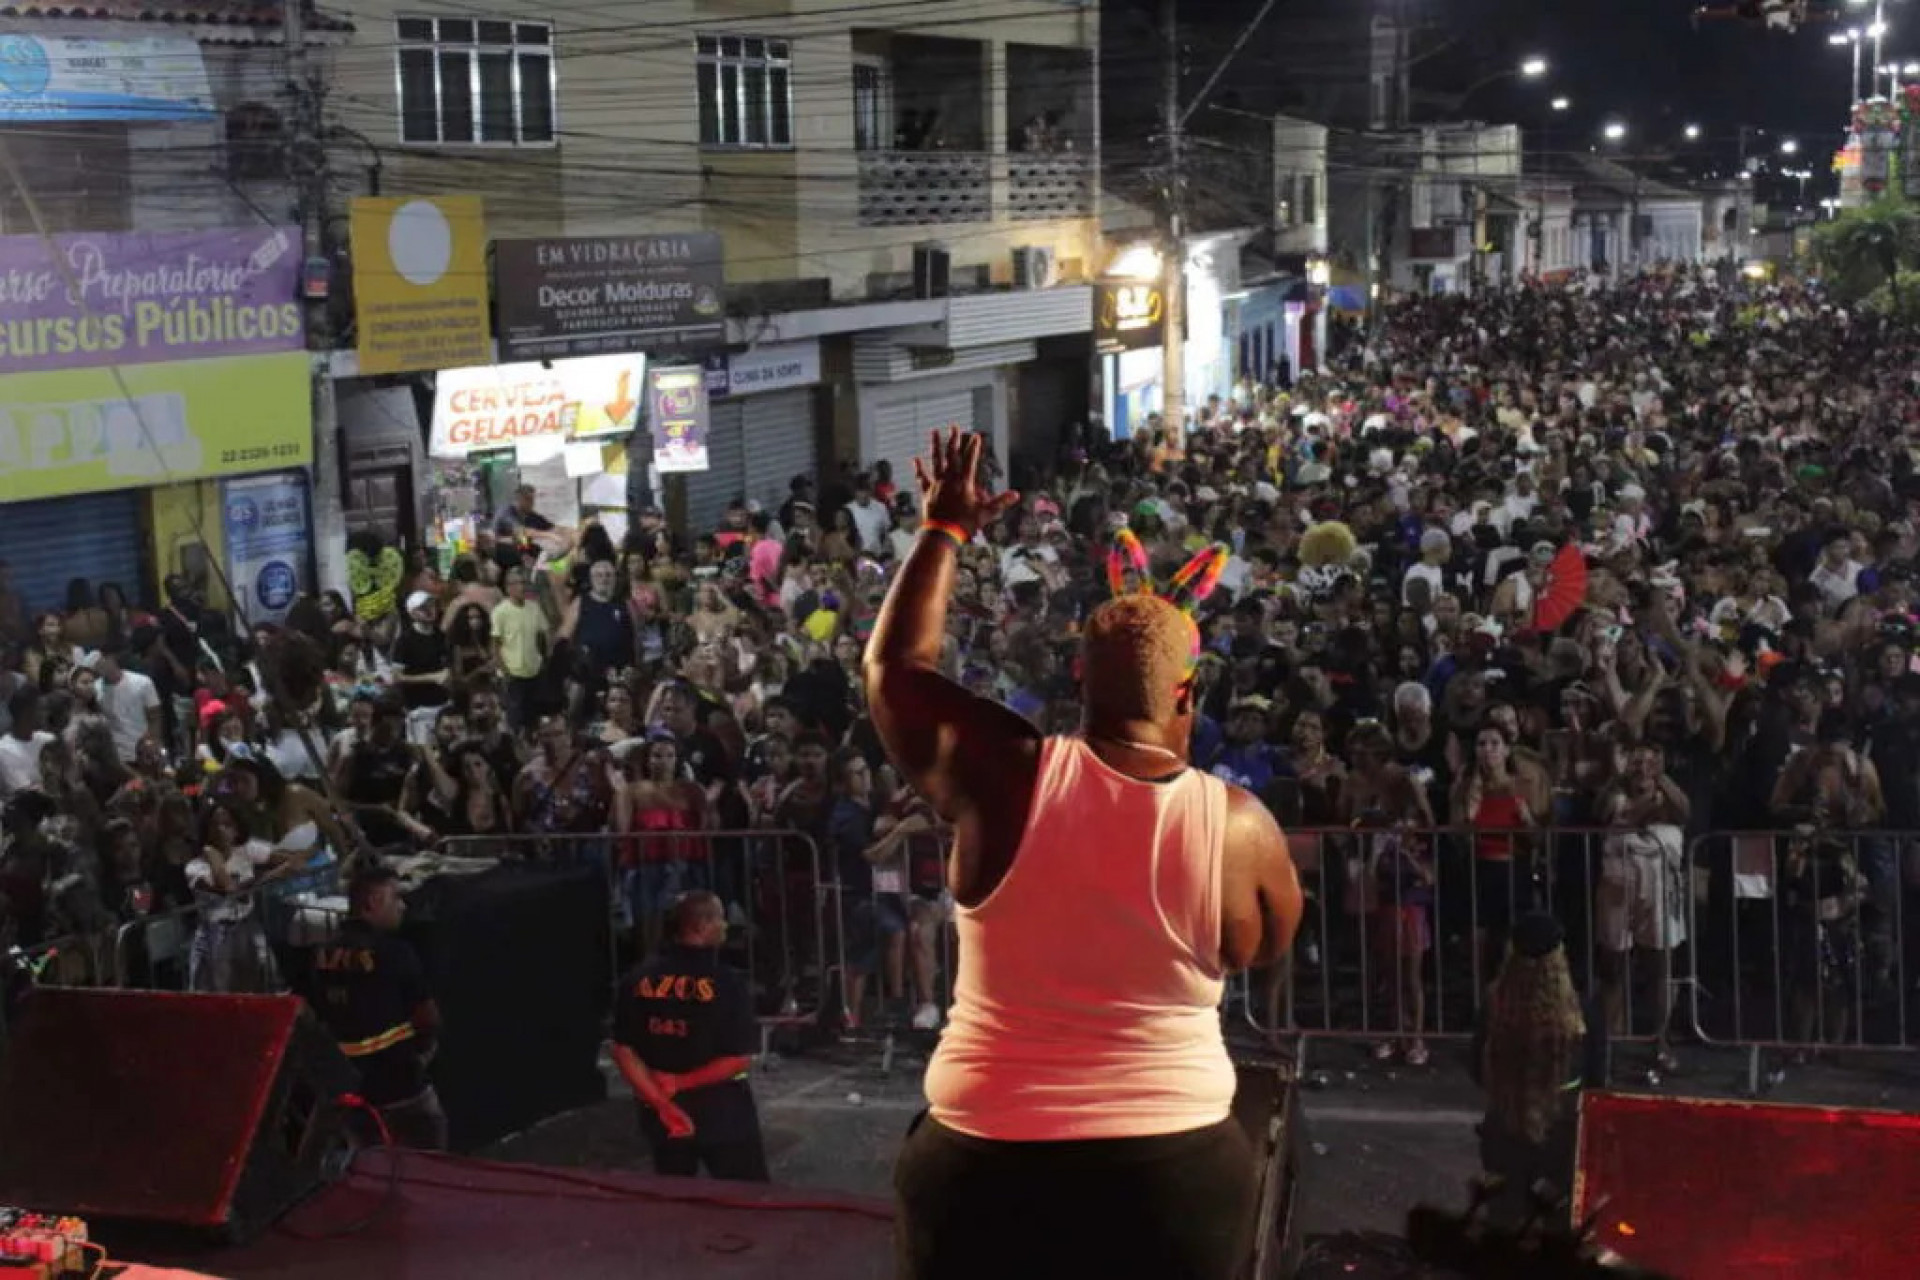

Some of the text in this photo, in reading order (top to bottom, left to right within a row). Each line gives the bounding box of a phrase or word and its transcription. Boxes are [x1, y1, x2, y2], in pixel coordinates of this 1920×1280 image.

[536, 244, 566, 265] EM
[538, 281, 694, 308] Decor Molduras
[135, 291, 300, 347] Públicos
[450, 380, 565, 414] CERVEJA
[449, 409, 562, 443] GELADA
[635, 973, 717, 1001] AZOS
